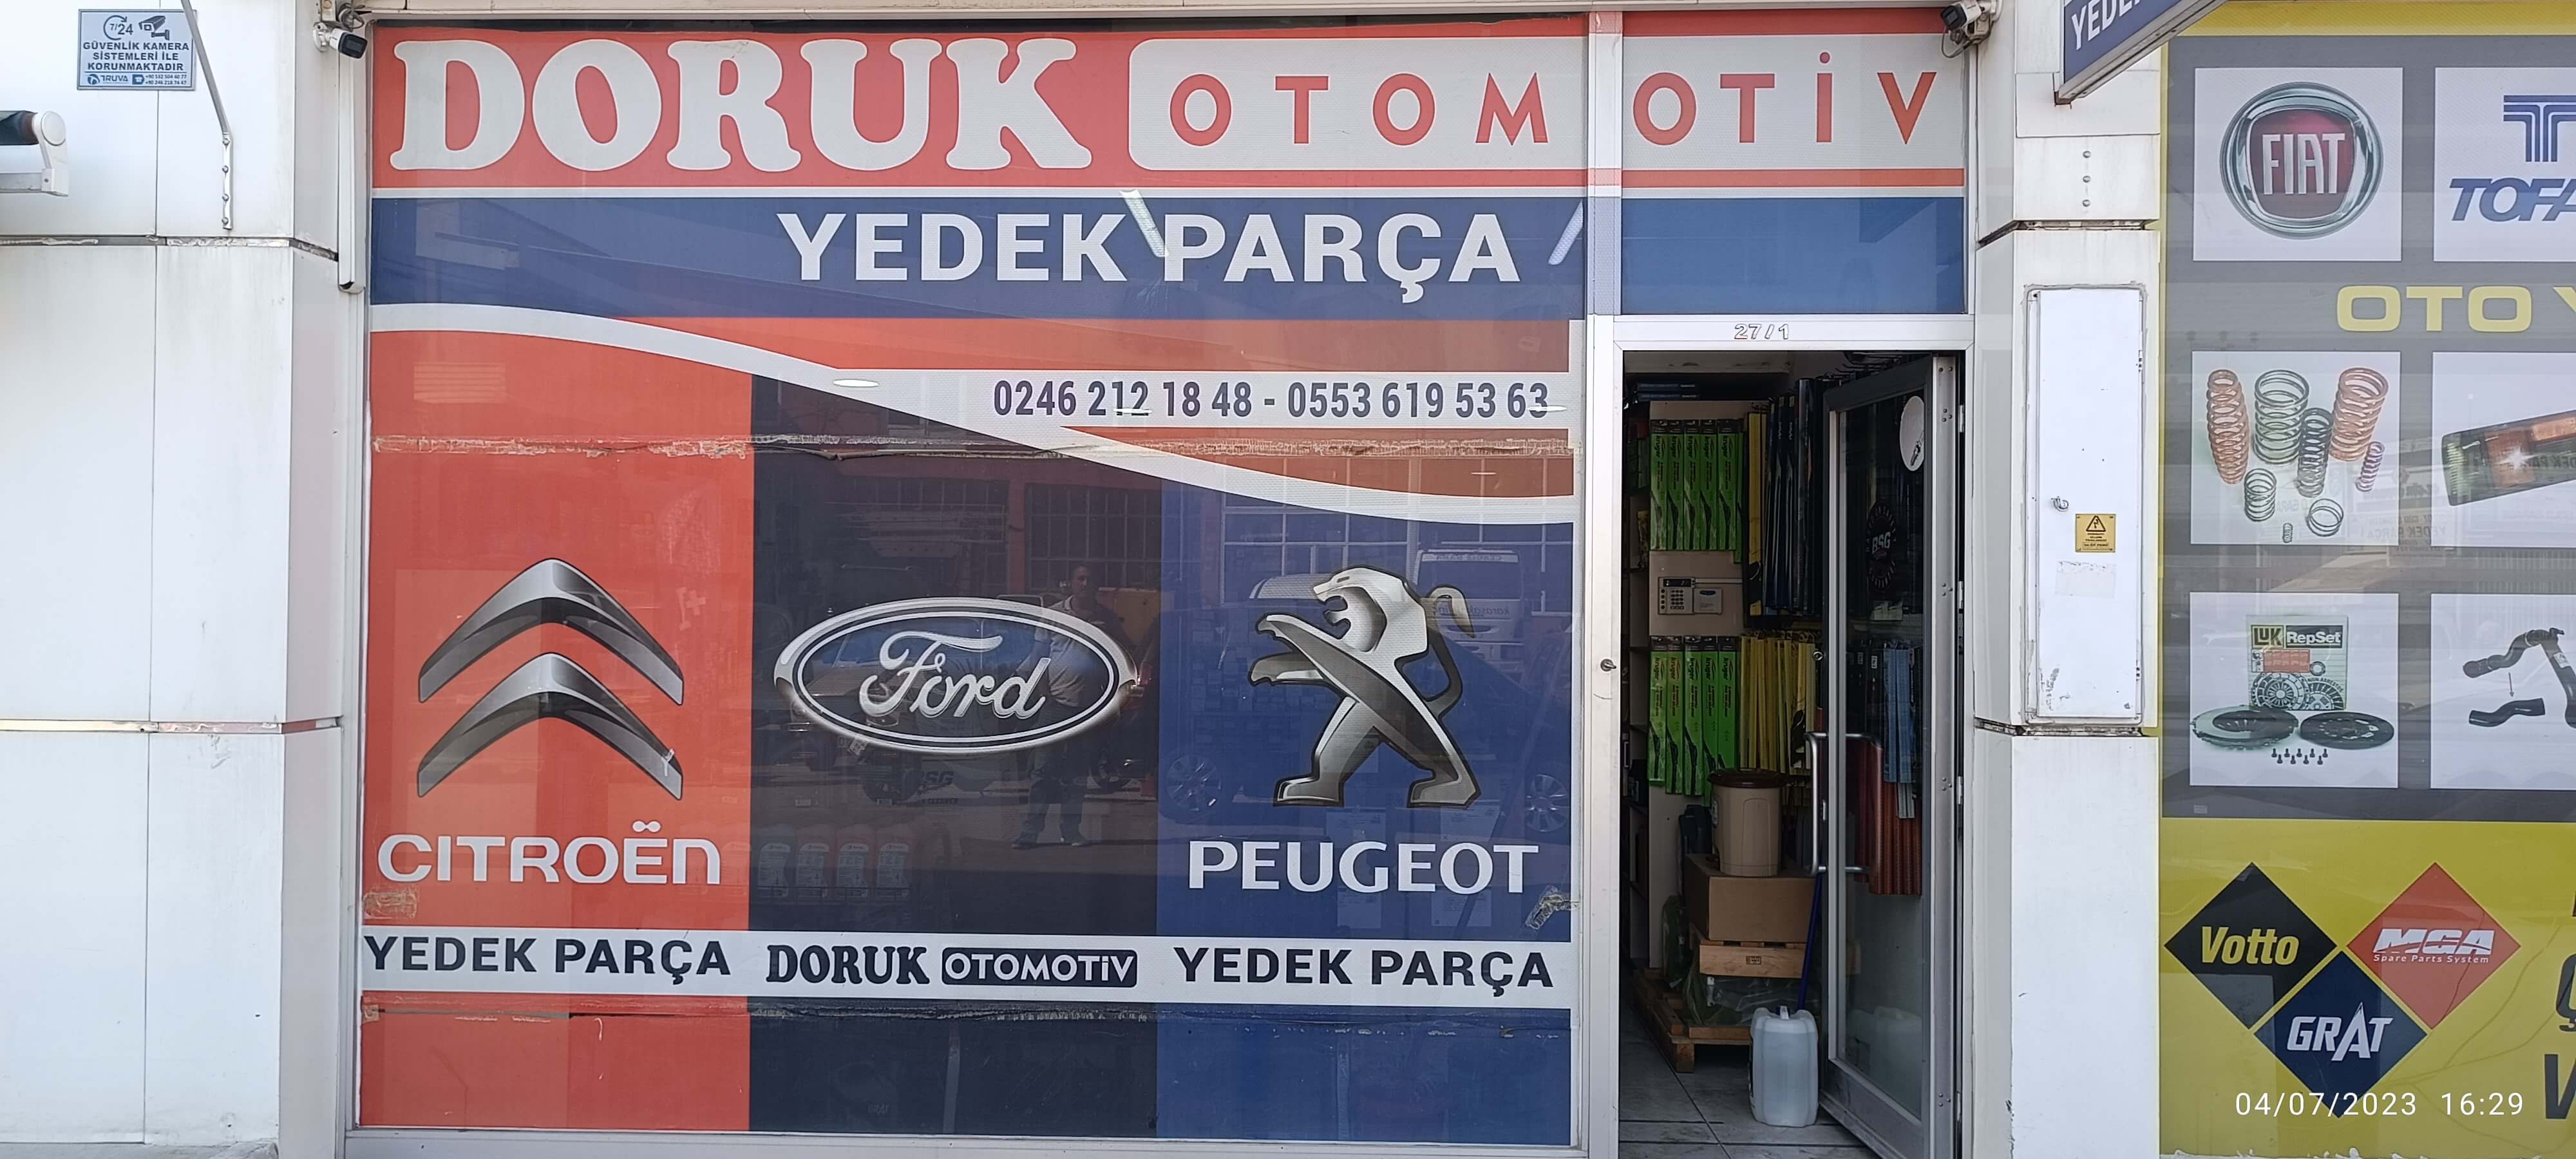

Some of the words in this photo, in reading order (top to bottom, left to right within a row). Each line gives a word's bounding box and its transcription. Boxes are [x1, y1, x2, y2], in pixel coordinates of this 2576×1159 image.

[83, 41, 140, 50] GÜVENLİK
[110, 23, 133, 35] 7/24
[2072, 0, 2141, 50] YED
[88, 62, 184, 71] KORUNMAKTADIR
[93, 51, 158, 60] SİSTEMLERİ
[162, 51, 178, 60] İLE
[390, 38, 1092, 171] DORUK
[1169, 52, 1938, 147] OTOMOTİV
[2262, 133, 2345, 195] FIAT
[777, 213, 1128, 281] YEDEK
[1163, 213, 1520, 304] PARÇA
[2336, 285, 2532, 332] OTO
[1734, 323, 1790, 340] 27/1
[994, 380, 1077, 416] 0246
[1088, 381, 1150, 417] 212
[1163, 381, 1200, 417] 18
[1211, 381, 1253, 417] 48
[1288, 382, 1371, 418] 0553
[1382, 382, 1444, 418] 619
[1455, 382, 1496, 418] 53
[1507, 382, 1548, 419] 63
[2287, 631, 2342, 645] RepSet
[860, 630, 1052, 719] Ford
[378, 820, 721, 885] CITROËN
[1189, 840, 1539, 894] PEUGEOT
[363, 935, 537, 972] YEDEK
[555, 939, 731, 985] PARÇA
[2202, 926, 2299, 965] Votto
[2373, 928, 2495, 955] MGA
[2373, 954, 2407, 963] Spare
[2411, 954, 2443, 963] Parts
[2447, 954, 2490, 964] System
[766, 945, 930, 985] DORUK
[1173, 947, 1353, 985] YEDEK
[1371, 950, 1554, 997] PARÇA
[2287, 1002, 2394, 1061] GRAT
